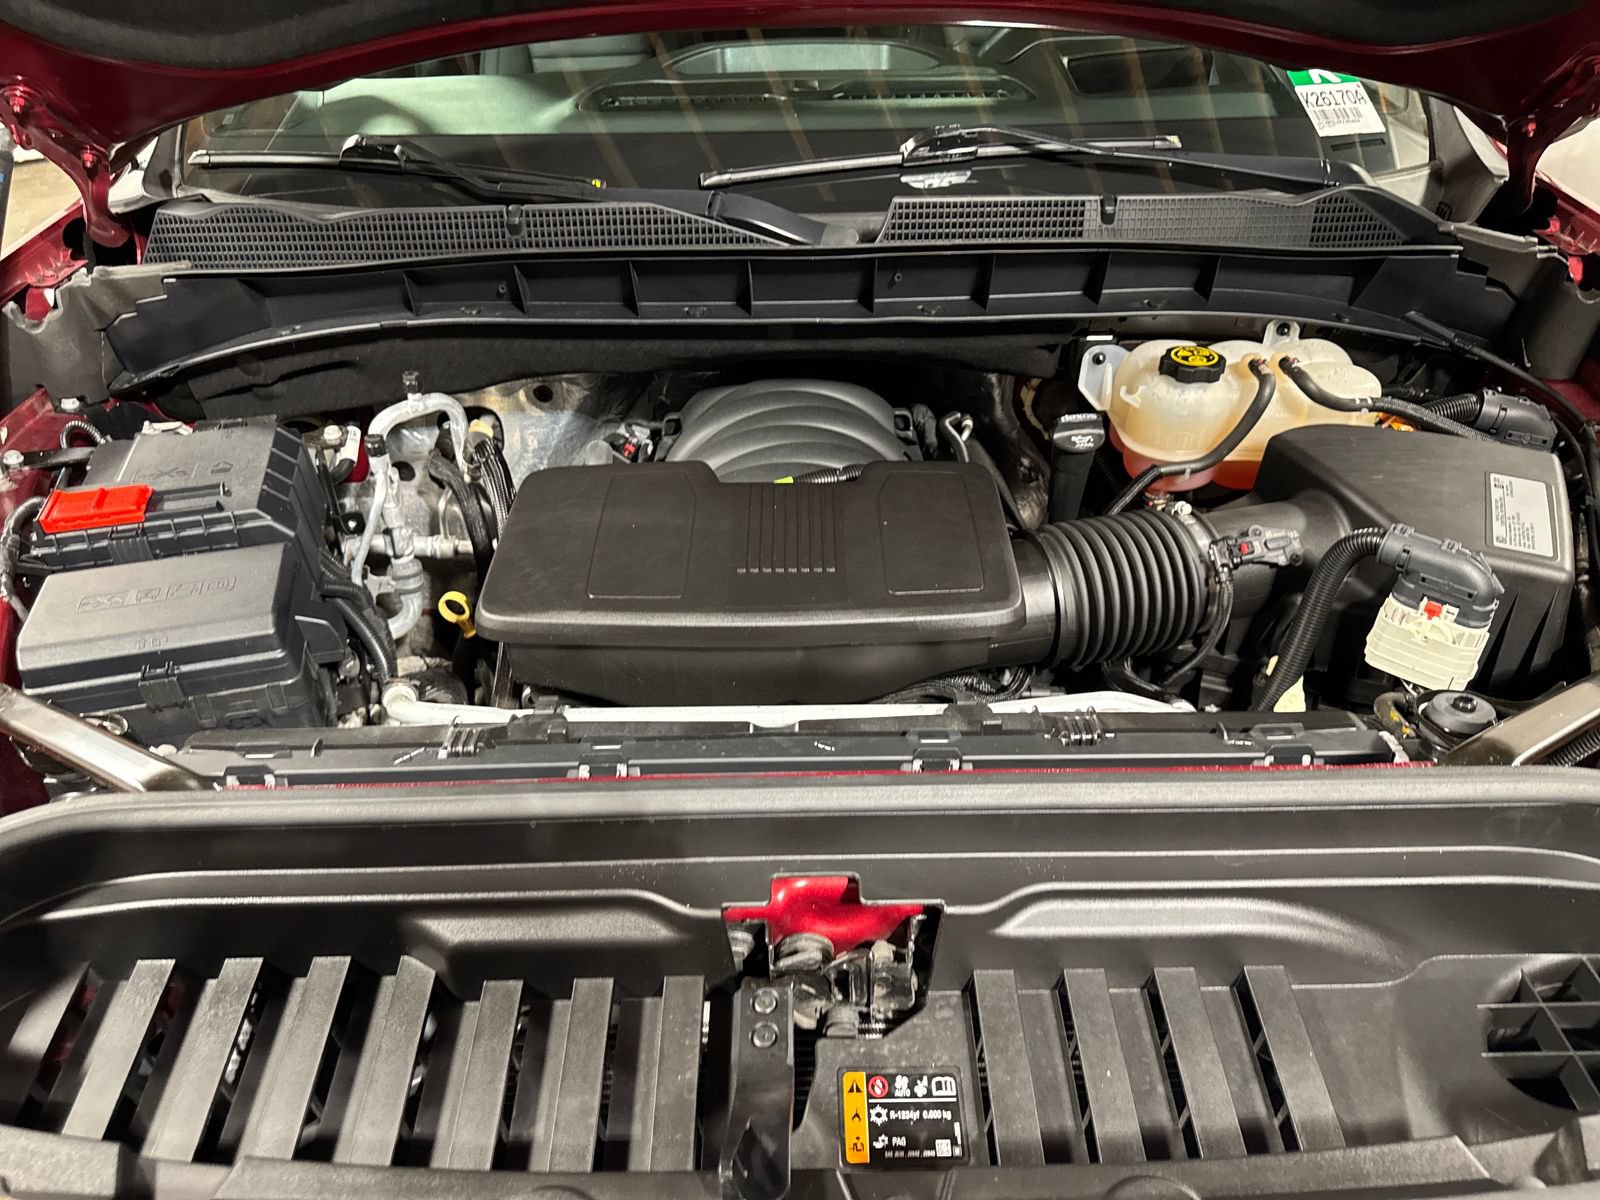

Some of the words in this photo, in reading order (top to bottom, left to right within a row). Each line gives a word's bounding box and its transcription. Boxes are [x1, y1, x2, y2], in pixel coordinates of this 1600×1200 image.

[1300, 89, 1367, 109] K26170A
[1061, 413, 1097, 422] dexos
[894, 1088, 911, 1097] AUTO
[889, 1109, 920, 1121] R-1234yf
[942, 1109, 952, 1121] kg
